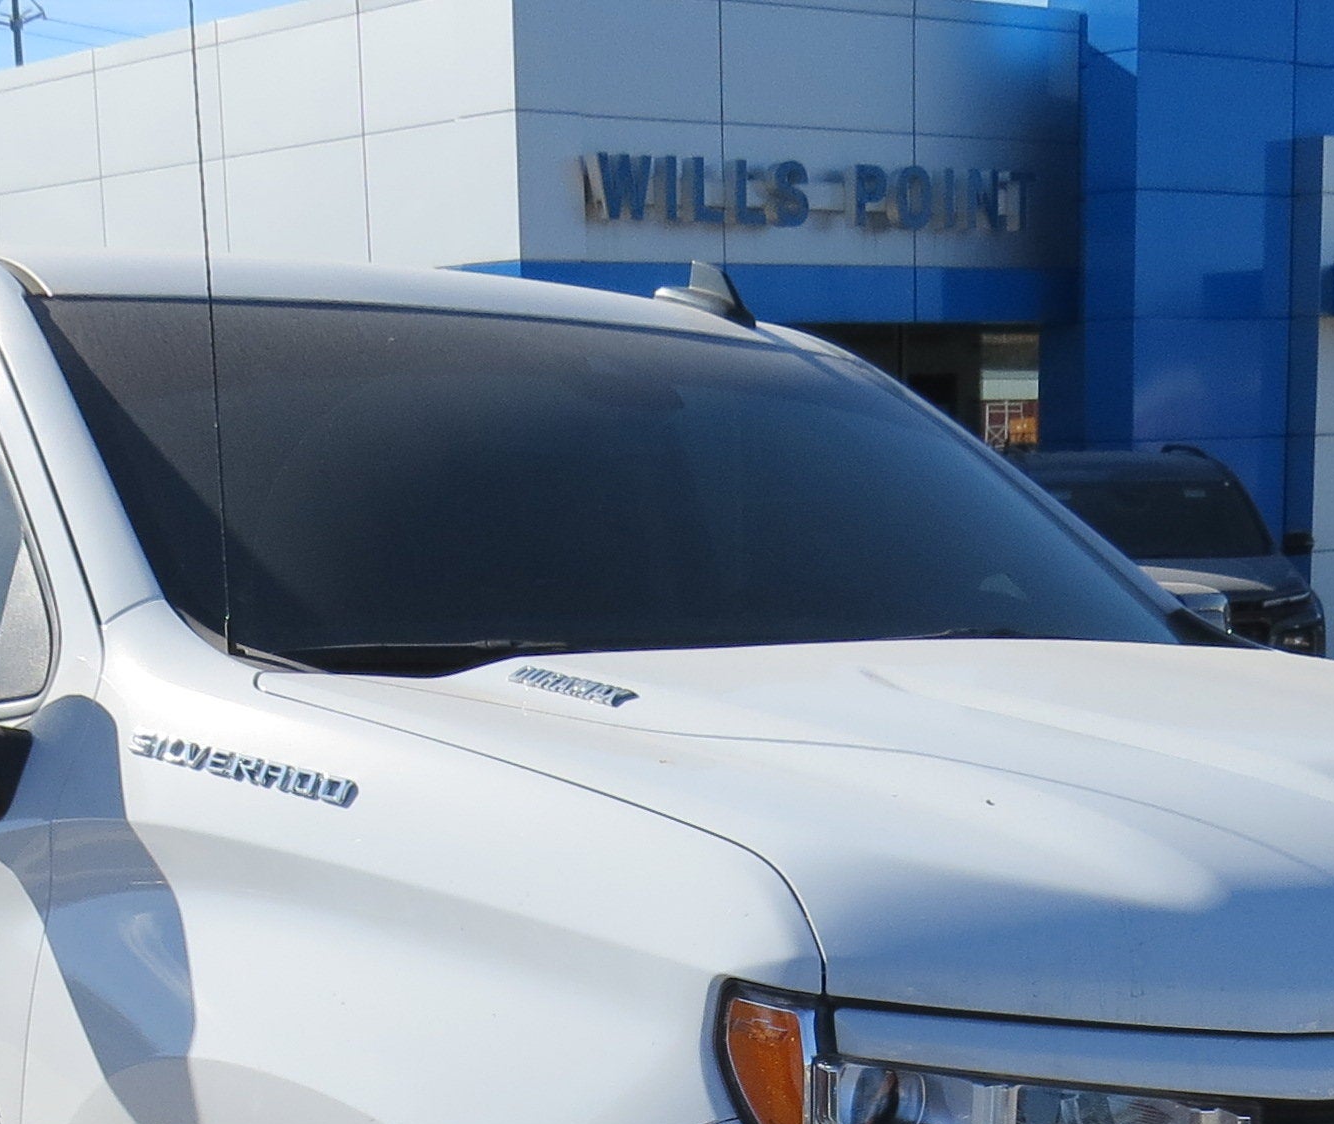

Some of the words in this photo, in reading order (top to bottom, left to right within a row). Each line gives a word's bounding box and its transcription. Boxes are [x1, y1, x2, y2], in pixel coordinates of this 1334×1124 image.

[575, 152, 809, 228] WILLS
[849, 163, 1036, 233] POINT
[128, 728, 359, 808] SILVERADO
